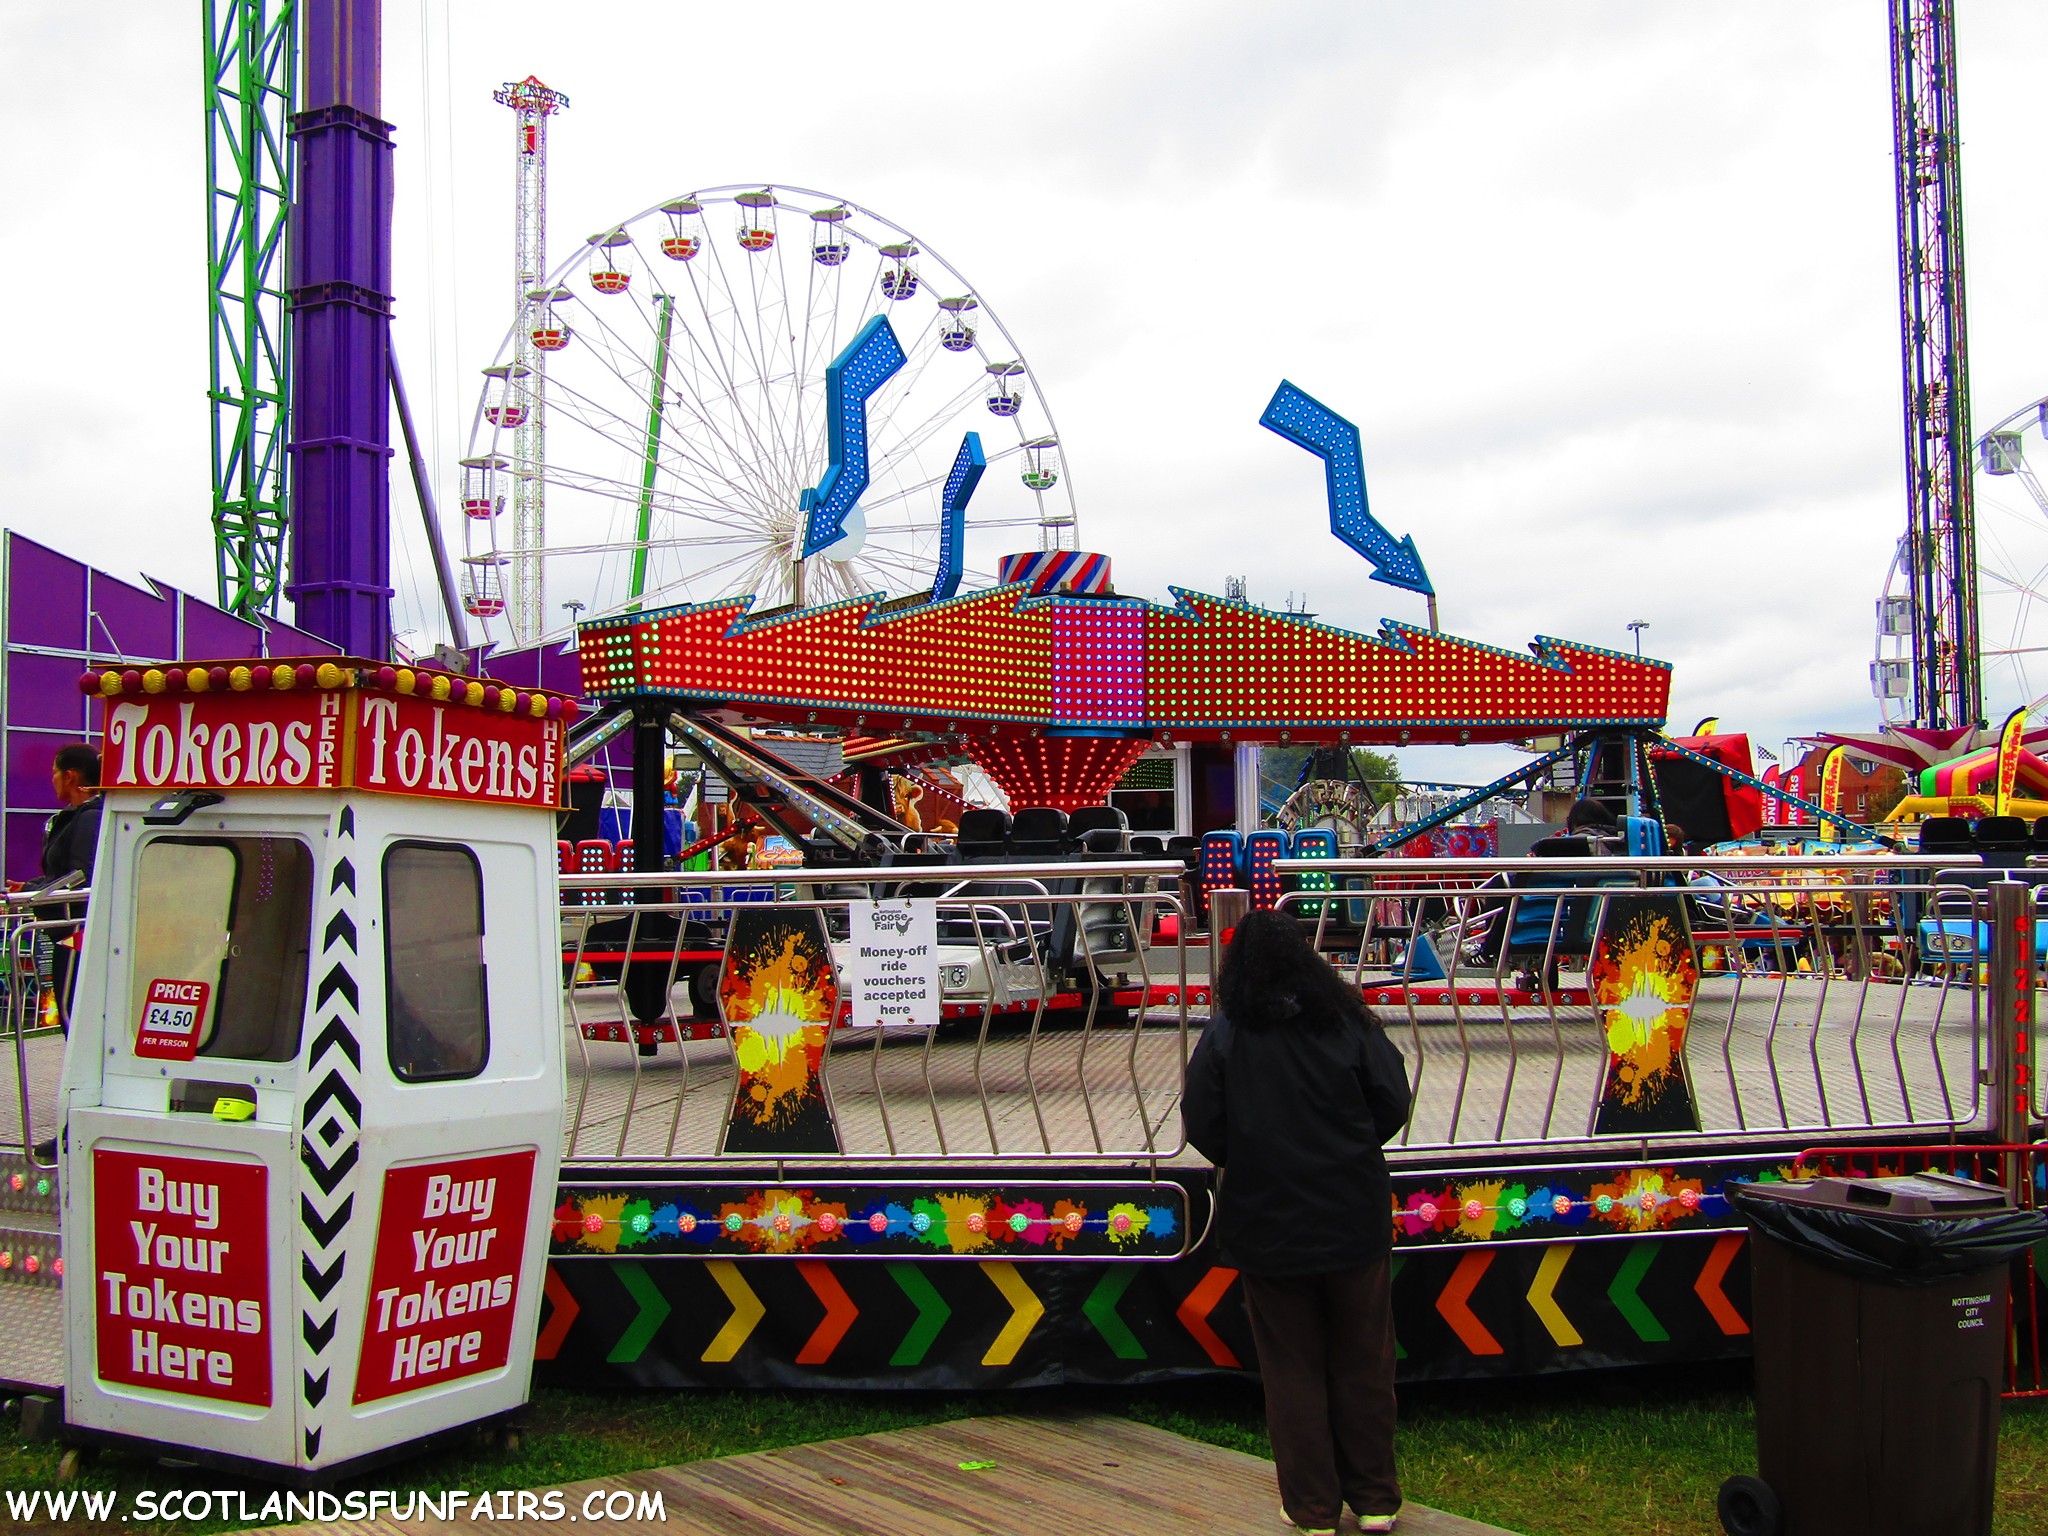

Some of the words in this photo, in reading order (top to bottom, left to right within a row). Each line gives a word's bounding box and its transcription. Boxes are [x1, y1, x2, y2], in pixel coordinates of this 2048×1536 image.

[110, 702, 312, 786] Tokens
[318, 693, 340, 788] HERE
[363, 697, 538, 799] Tokens
[543, 719, 558, 805] HERE
[871, 912, 908, 921] Goose
[874, 921, 895, 931] Fair
[860, 945, 928, 958] Money-off
[881, 960, 907, 971] ride
[864, 975, 926, 986] vouchers
[154, 983, 201, 1000] PRICE
[864, 989, 926, 1002] accepted
[149, 1008, 193, 1027] £4.50
[880, 1004, 911, 1015] here
[142, 1037, 157, 1045] PER
[159, 1038, 189, 1047] PERSON
[138, 1167, 219, 1230] Buy
[423, 1174, 497, 1222] Buy
[130, 1220, 230, 1274] Your
[412, 1227, 497, 1273] Your
[103, 1271, 261, 1335] Tokens
[377, 1274, 513, 1333] Tokens
[1952, 1294, 1991, 1306] NOTTINGHAM
[1965, 1307, 1979, 1316] CITY
[1957, 1318, 1984, 1329] COUNCIL
[131, 1328, 233, 1386] Here
[390, 1330, 482, 1383] Here
